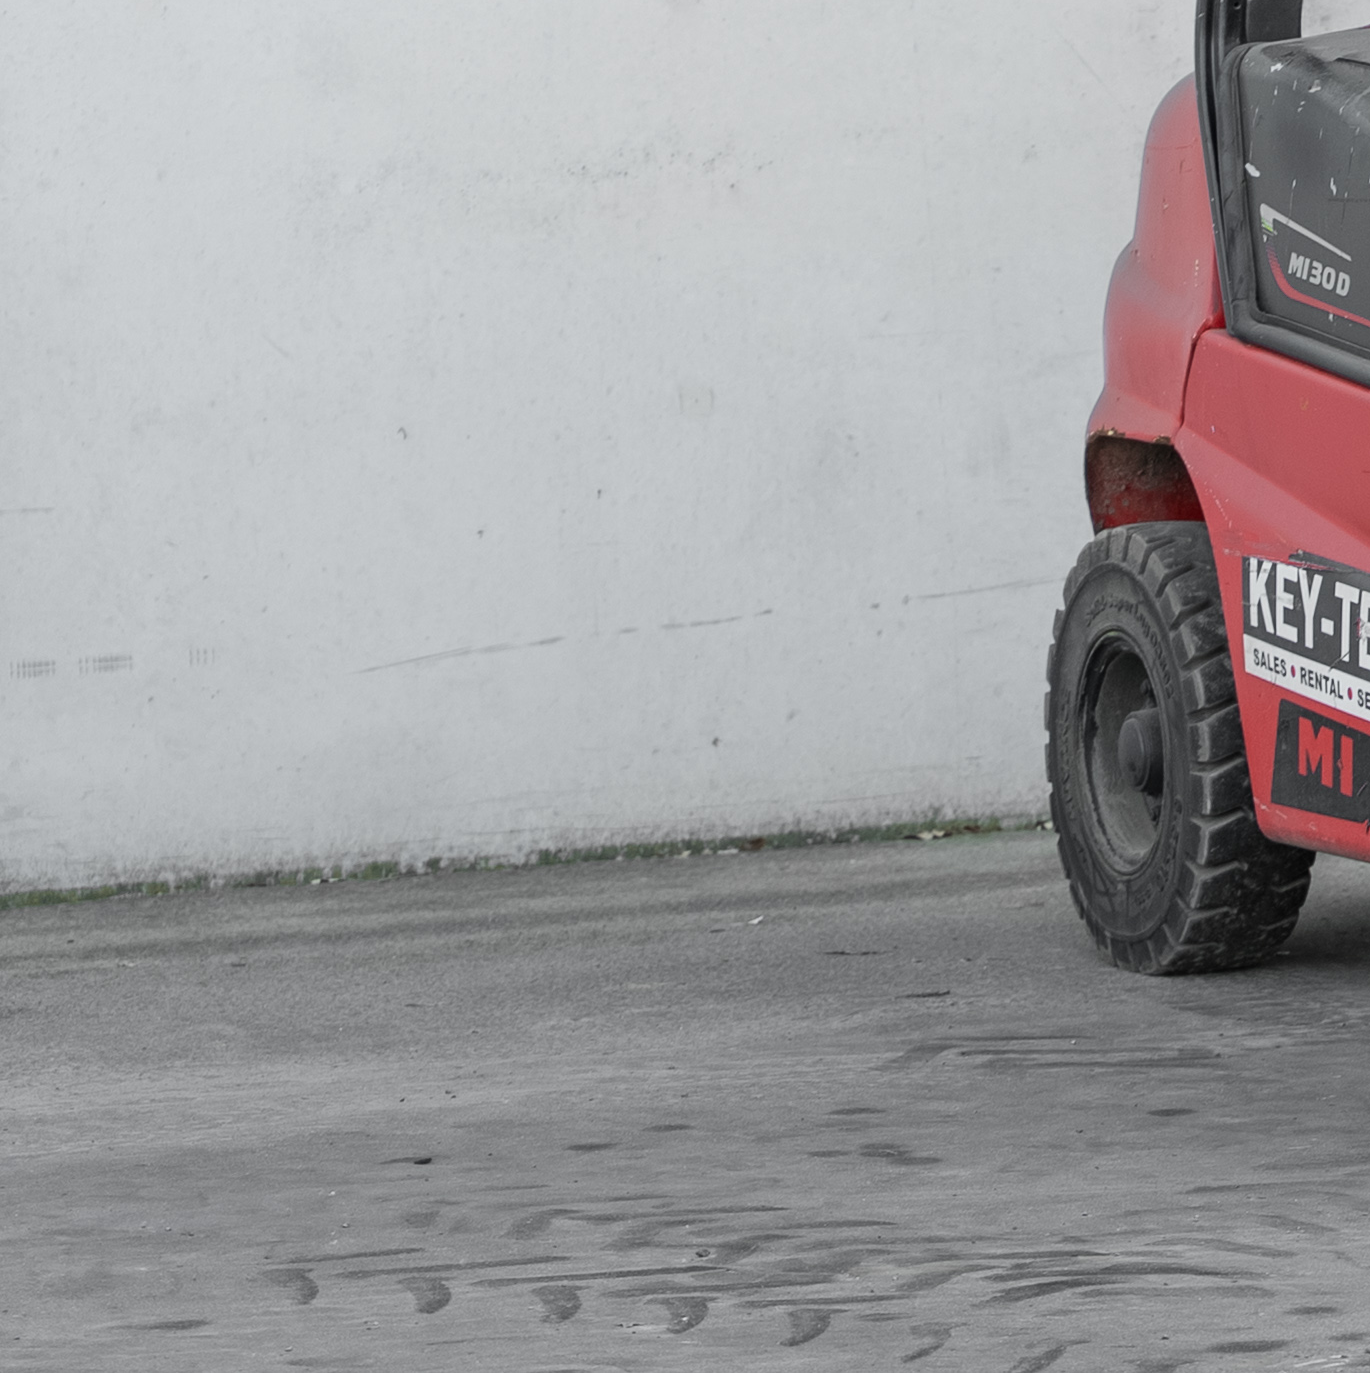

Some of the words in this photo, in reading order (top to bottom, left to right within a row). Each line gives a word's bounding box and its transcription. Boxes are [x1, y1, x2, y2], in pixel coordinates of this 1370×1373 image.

[1253, 648, 1287, 678] SALES
[1300, 666, 1344, 701] RENTAL
[1298, 716, 1354, 798] MI
